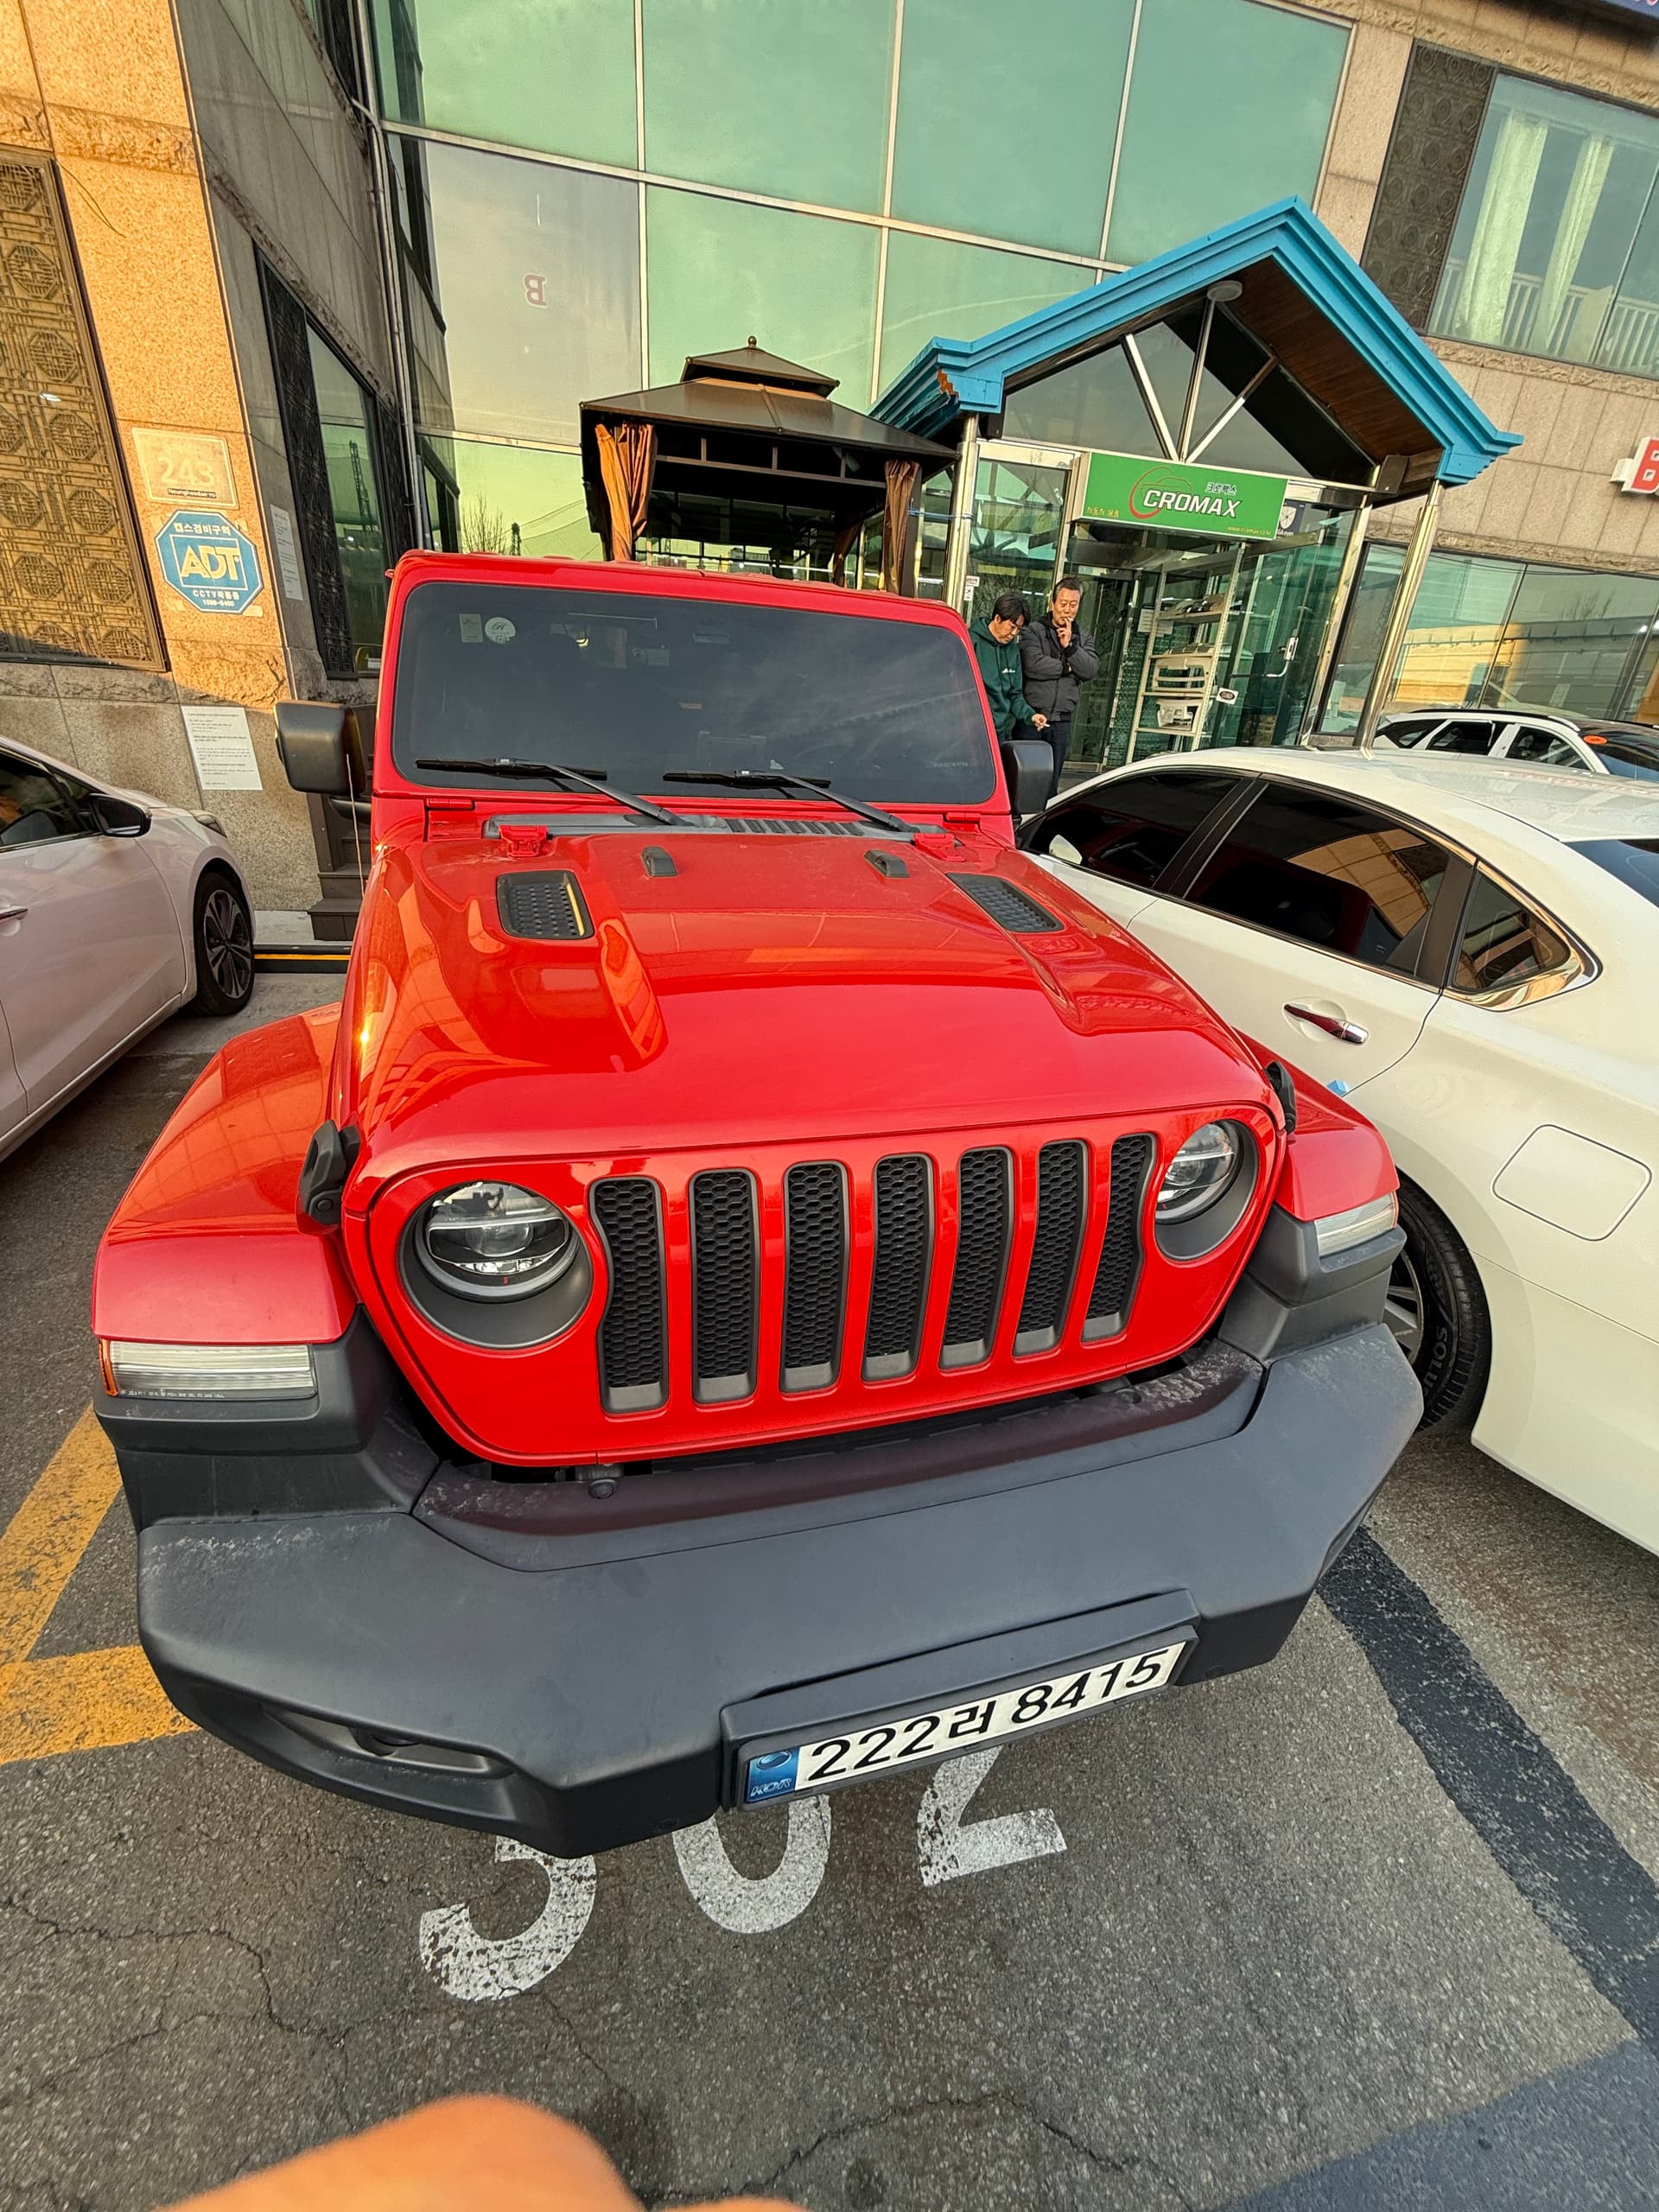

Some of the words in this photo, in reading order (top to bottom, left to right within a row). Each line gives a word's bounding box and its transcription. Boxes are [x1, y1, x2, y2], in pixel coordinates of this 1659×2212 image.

[158, 458, 215, 486] 243
[1143, 489, 1243, 518] CROMAX
[181, 545, 239, 580] ADT
[808, 1700, 996, 1781] 222러
[1011, 1648, 1170, 1725] 8415
[750, 1777, 792, 1797] KOR
